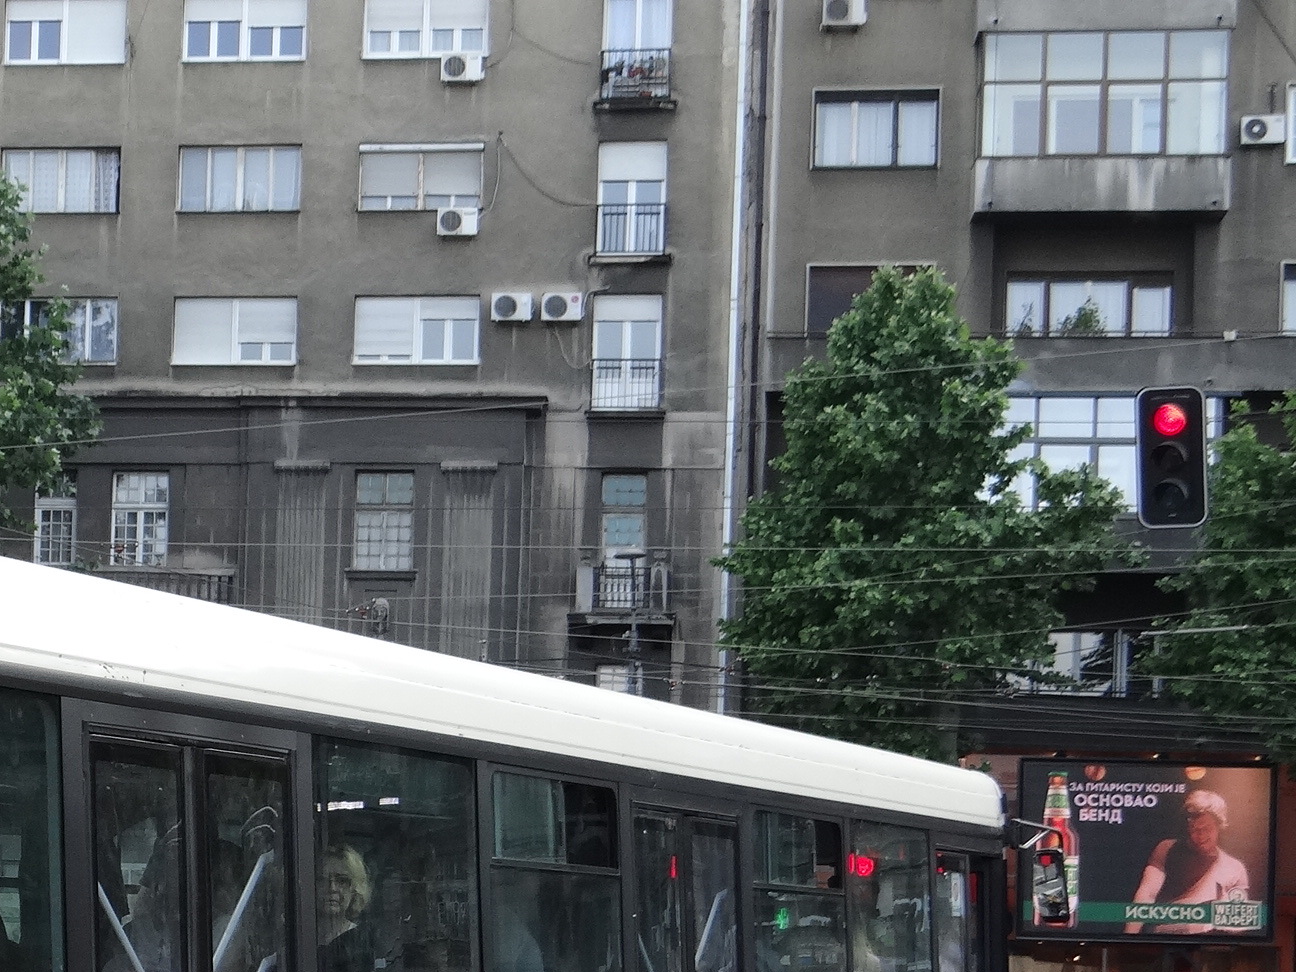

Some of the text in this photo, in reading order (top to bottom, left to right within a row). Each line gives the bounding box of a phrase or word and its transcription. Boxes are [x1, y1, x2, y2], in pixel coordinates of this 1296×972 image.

[1069, 783, 1186, 793] ЗА ГИТАРИСТУ КОЈИ ЈЕ
[1073, 793, 1158, 808] ОСНОВАО
[1079, 808, 1123, 825] БЕНД
[1125, 905, 1205, 920] ИСКУСНО
[1214, 904, 1258, 916] WEIFERT
[1214, 915, 1258, 926] ВАЈФЕРТ
